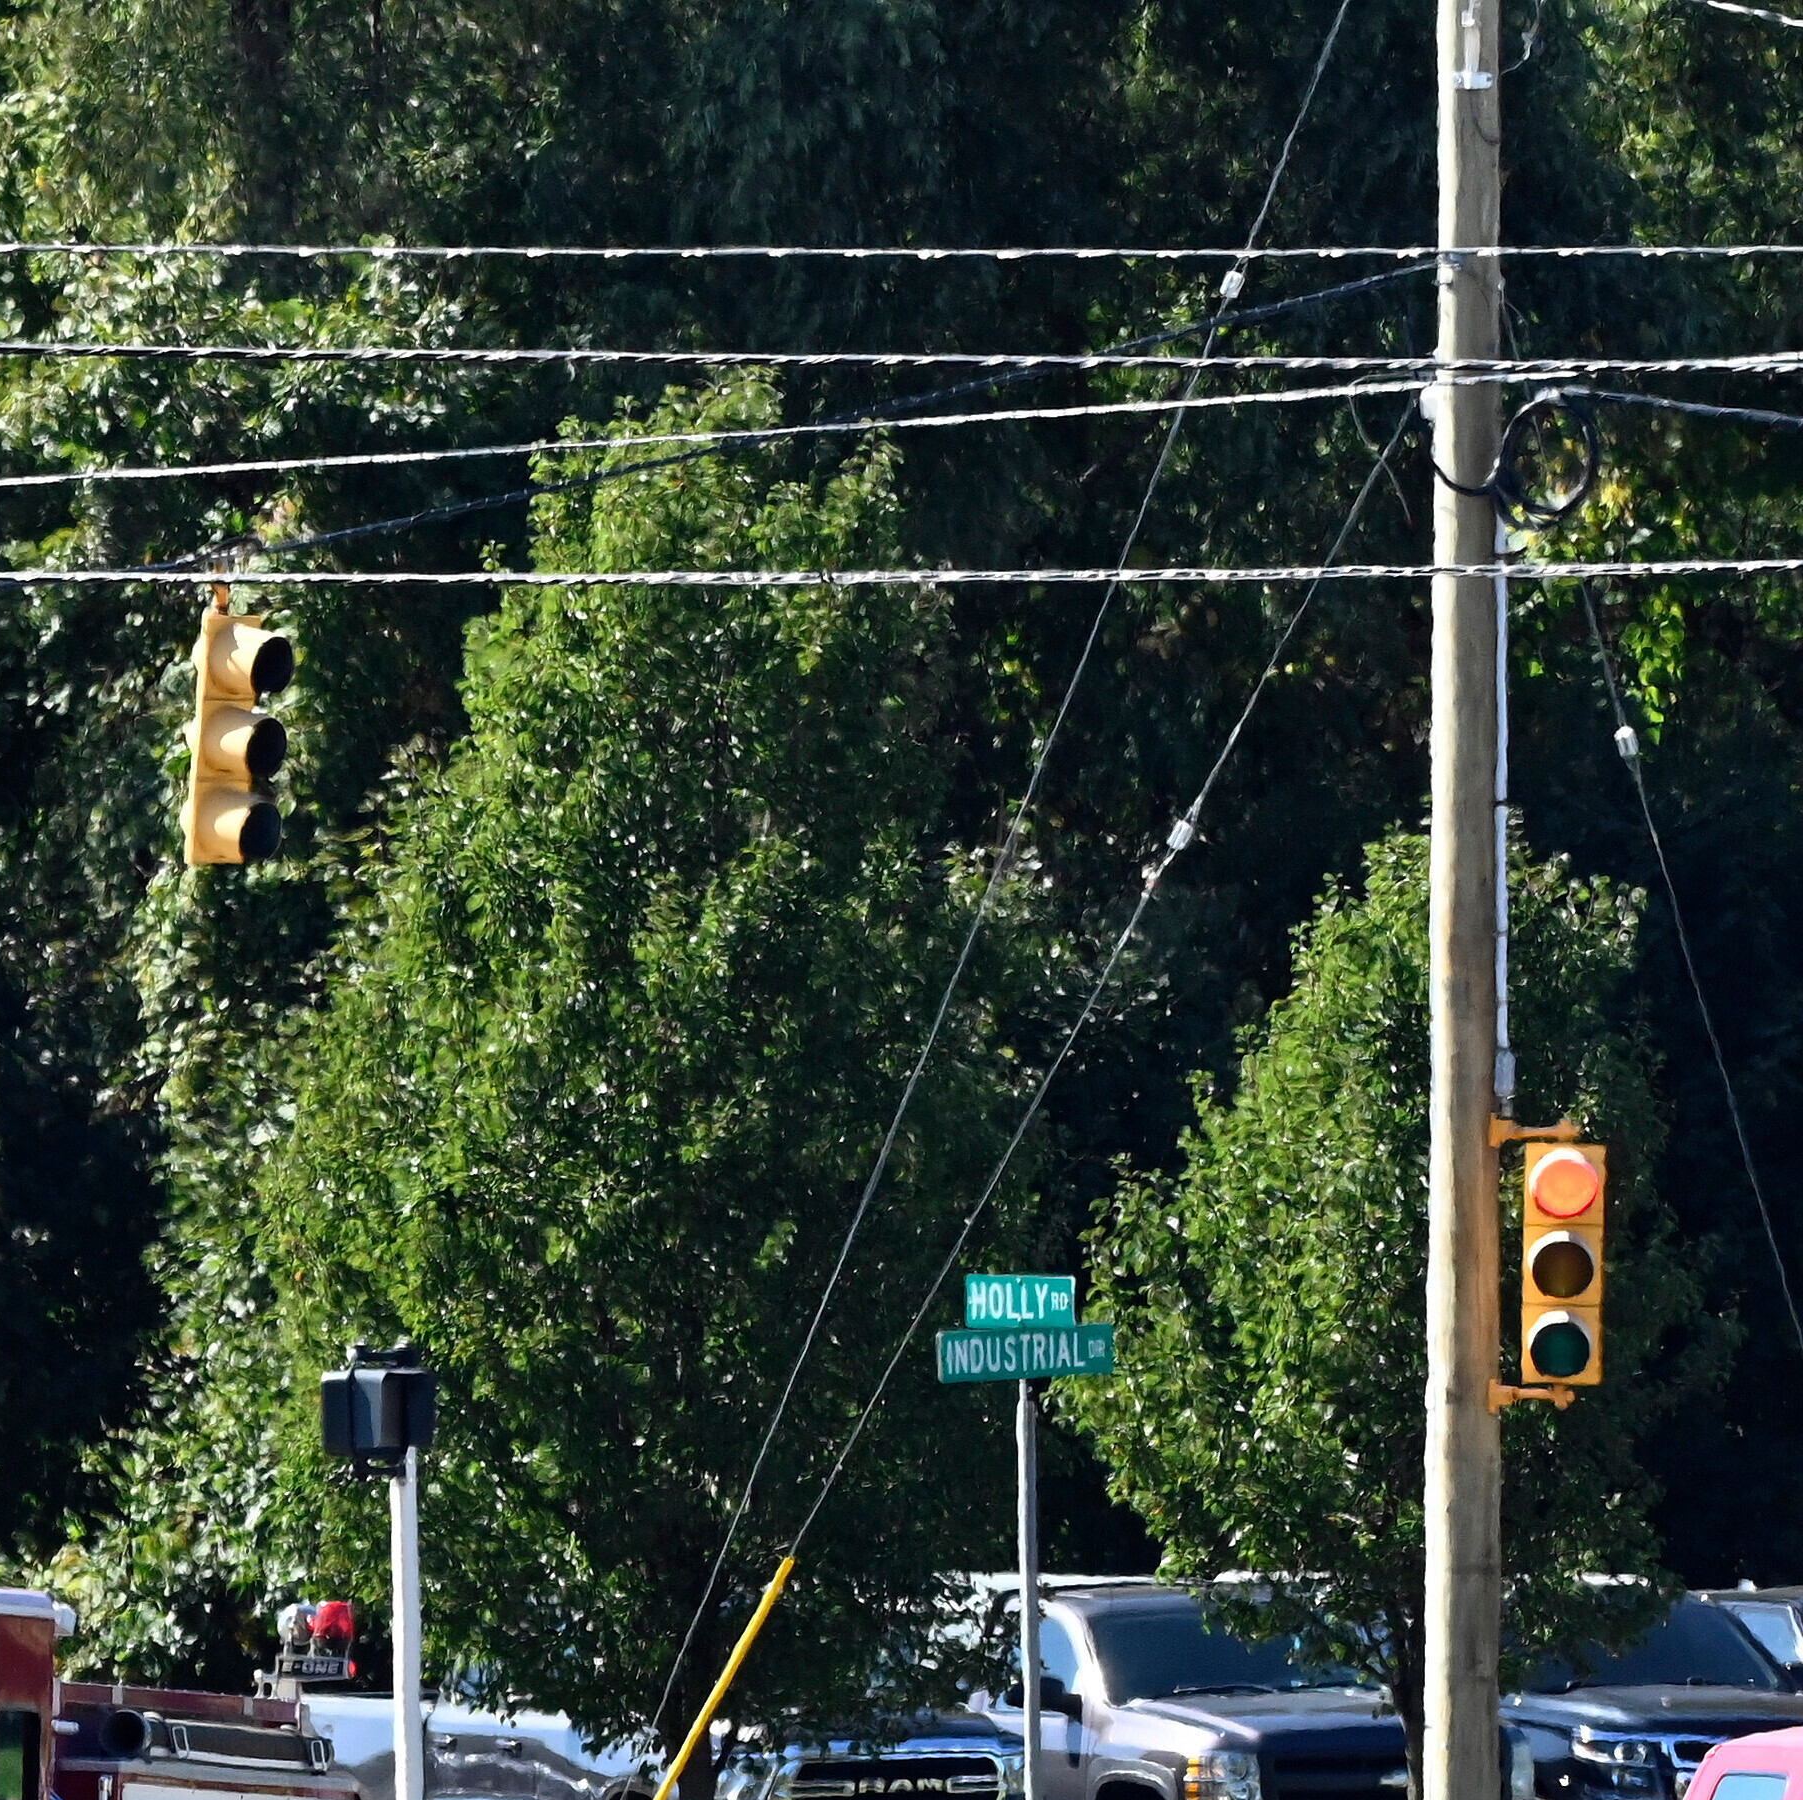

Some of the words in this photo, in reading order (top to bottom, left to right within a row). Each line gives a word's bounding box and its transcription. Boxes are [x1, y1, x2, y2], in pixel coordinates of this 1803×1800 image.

[970, 1281, 1049, 1320] HOLLY
[1051, 1291, 1070, 1311] RD
[946, 1331, 1086, 1375] INDUSTRIAL
[1087, 1339, 1106, 1359] DR
[858, 1776, 944, 1794] RAM
